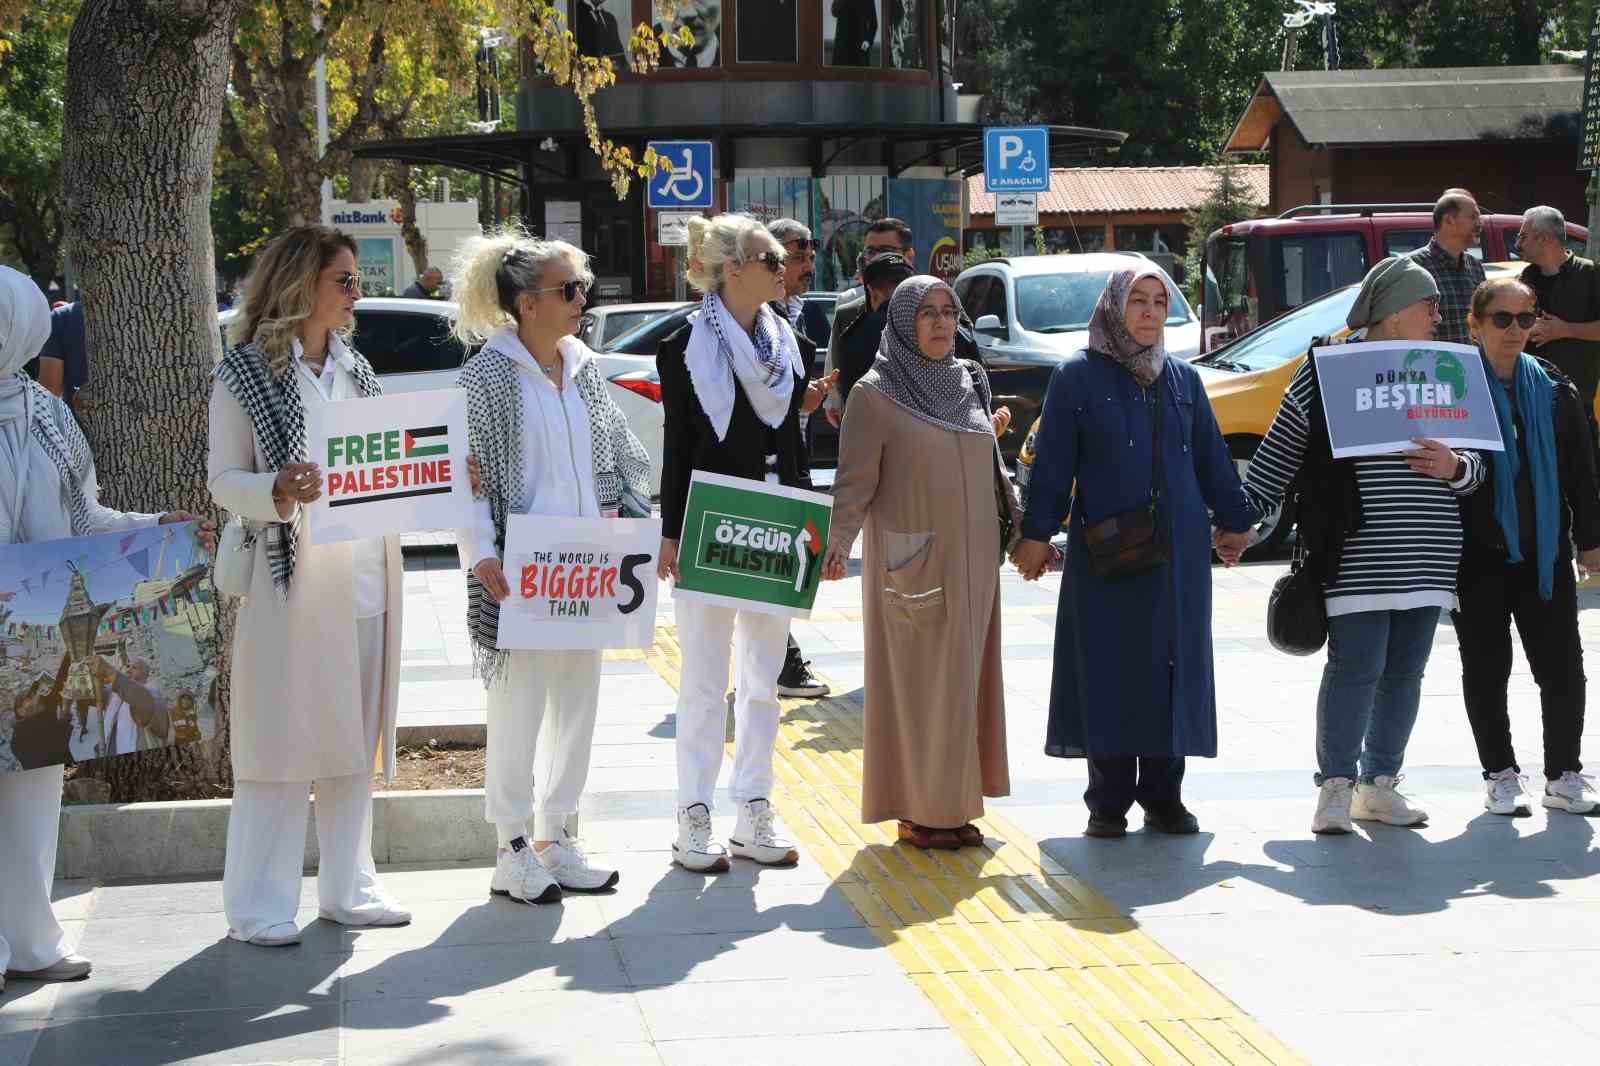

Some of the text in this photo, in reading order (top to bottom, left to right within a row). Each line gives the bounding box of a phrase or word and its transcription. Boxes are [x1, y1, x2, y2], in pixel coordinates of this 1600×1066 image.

[1000, 135, 1023, 170] P
[1000, 177, 1043, 187] ARAÇLIK
[1375, 369, 1427, 385] DÜNYA
[1355, 383, 1453, 412] BEŞTEN
[327, 430, 401, 467] FREE
[327, 459, 452, 496] PALESTINE
[715, 519, 792, 554] ÖZGÜR
[534, 552, 609, 564] THE WORLD IS
[520, 564, 618, 599] BIGGER
[617, 553, 652, 614] 5
[549, 600, 589, 616] THAN
